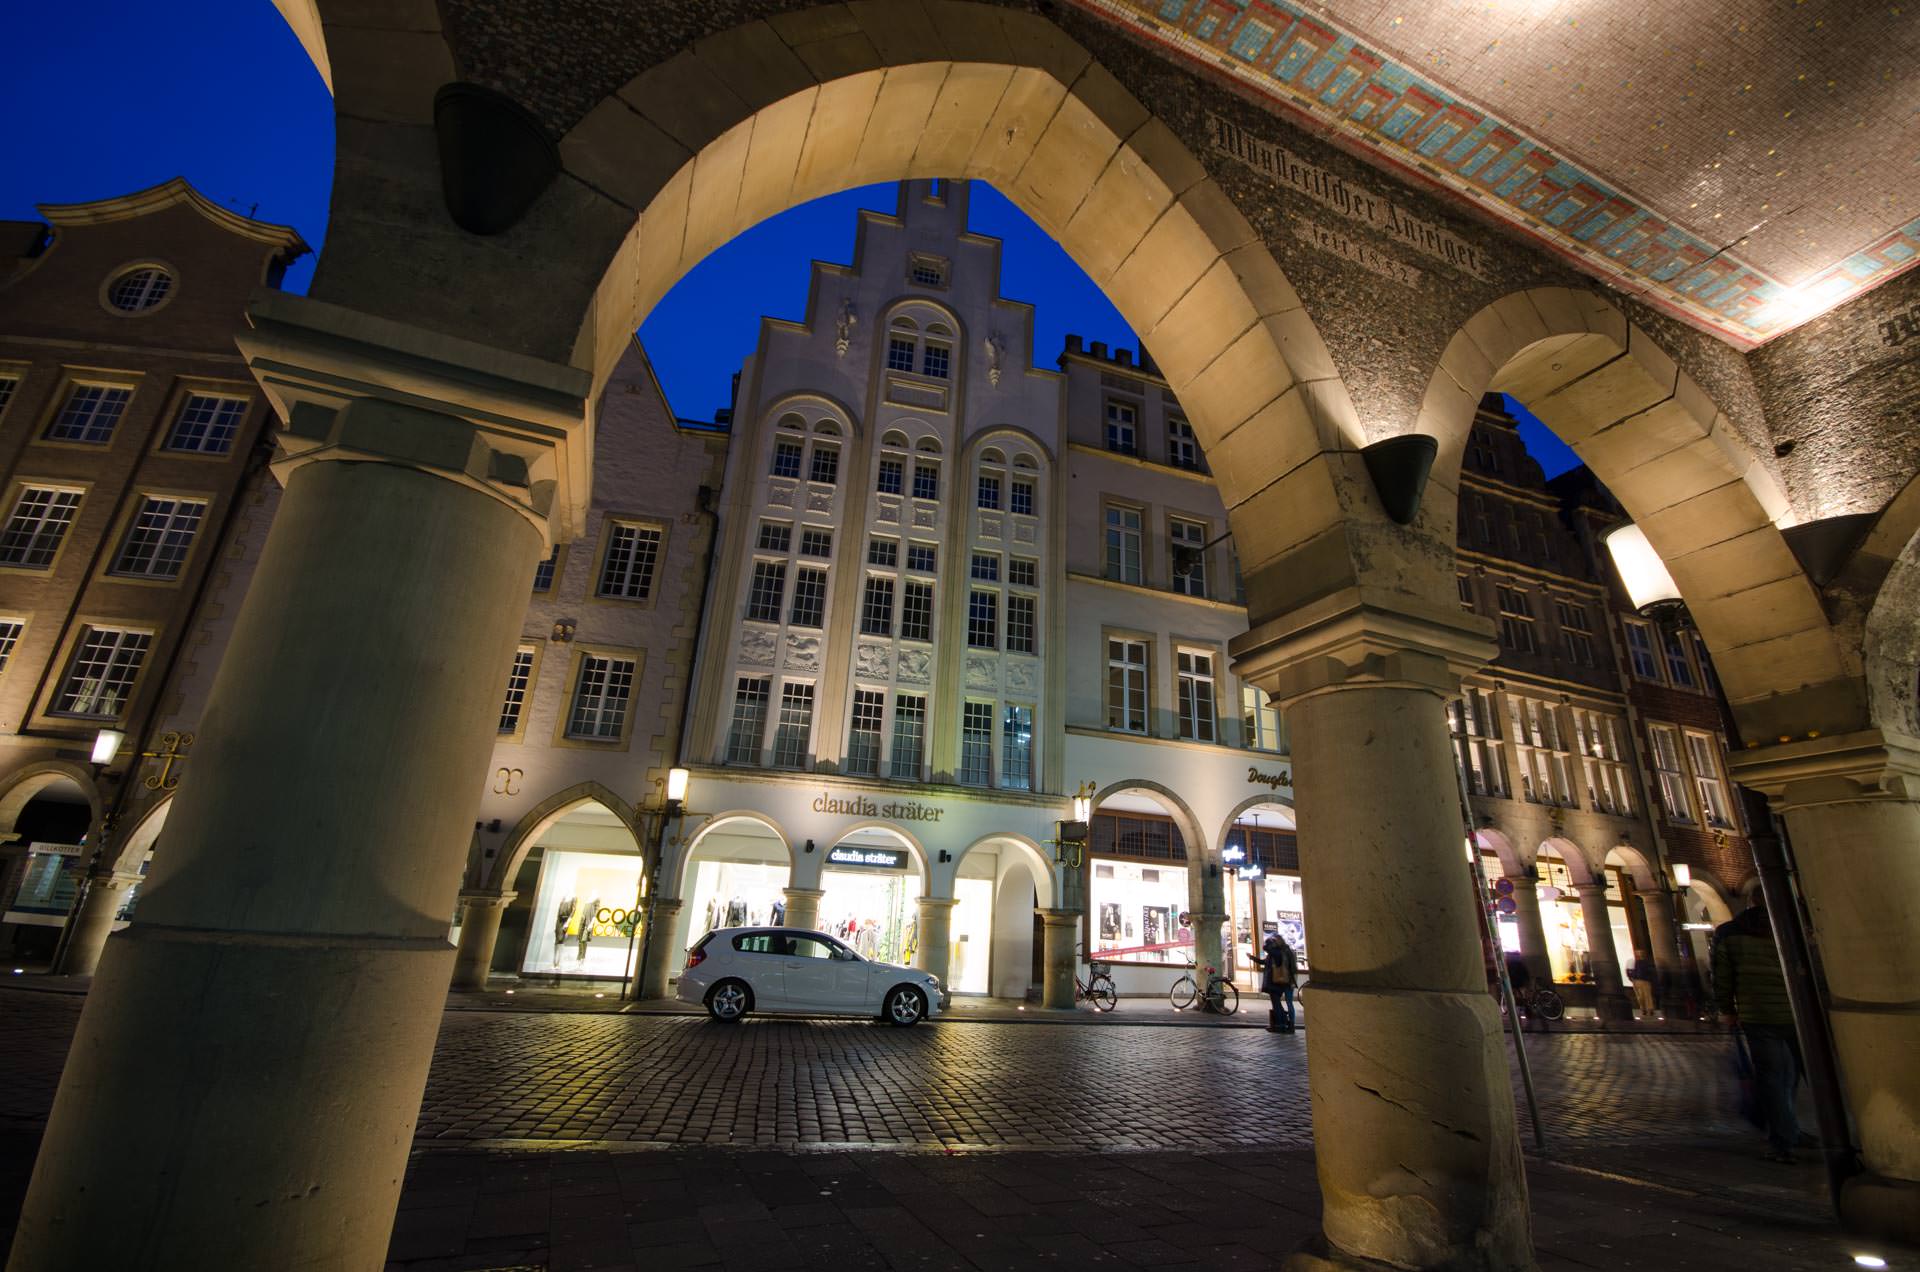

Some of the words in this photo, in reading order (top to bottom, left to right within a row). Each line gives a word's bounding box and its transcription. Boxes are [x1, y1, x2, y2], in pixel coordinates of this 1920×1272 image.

[1384, 201, 1478, 270] Anzeiger
[813, 791, 878, 817] claudia
[881, 801, 944, 821] sträter
[831, 849, 864, 862] claudia
[865, 851, 897, 865] sträter
